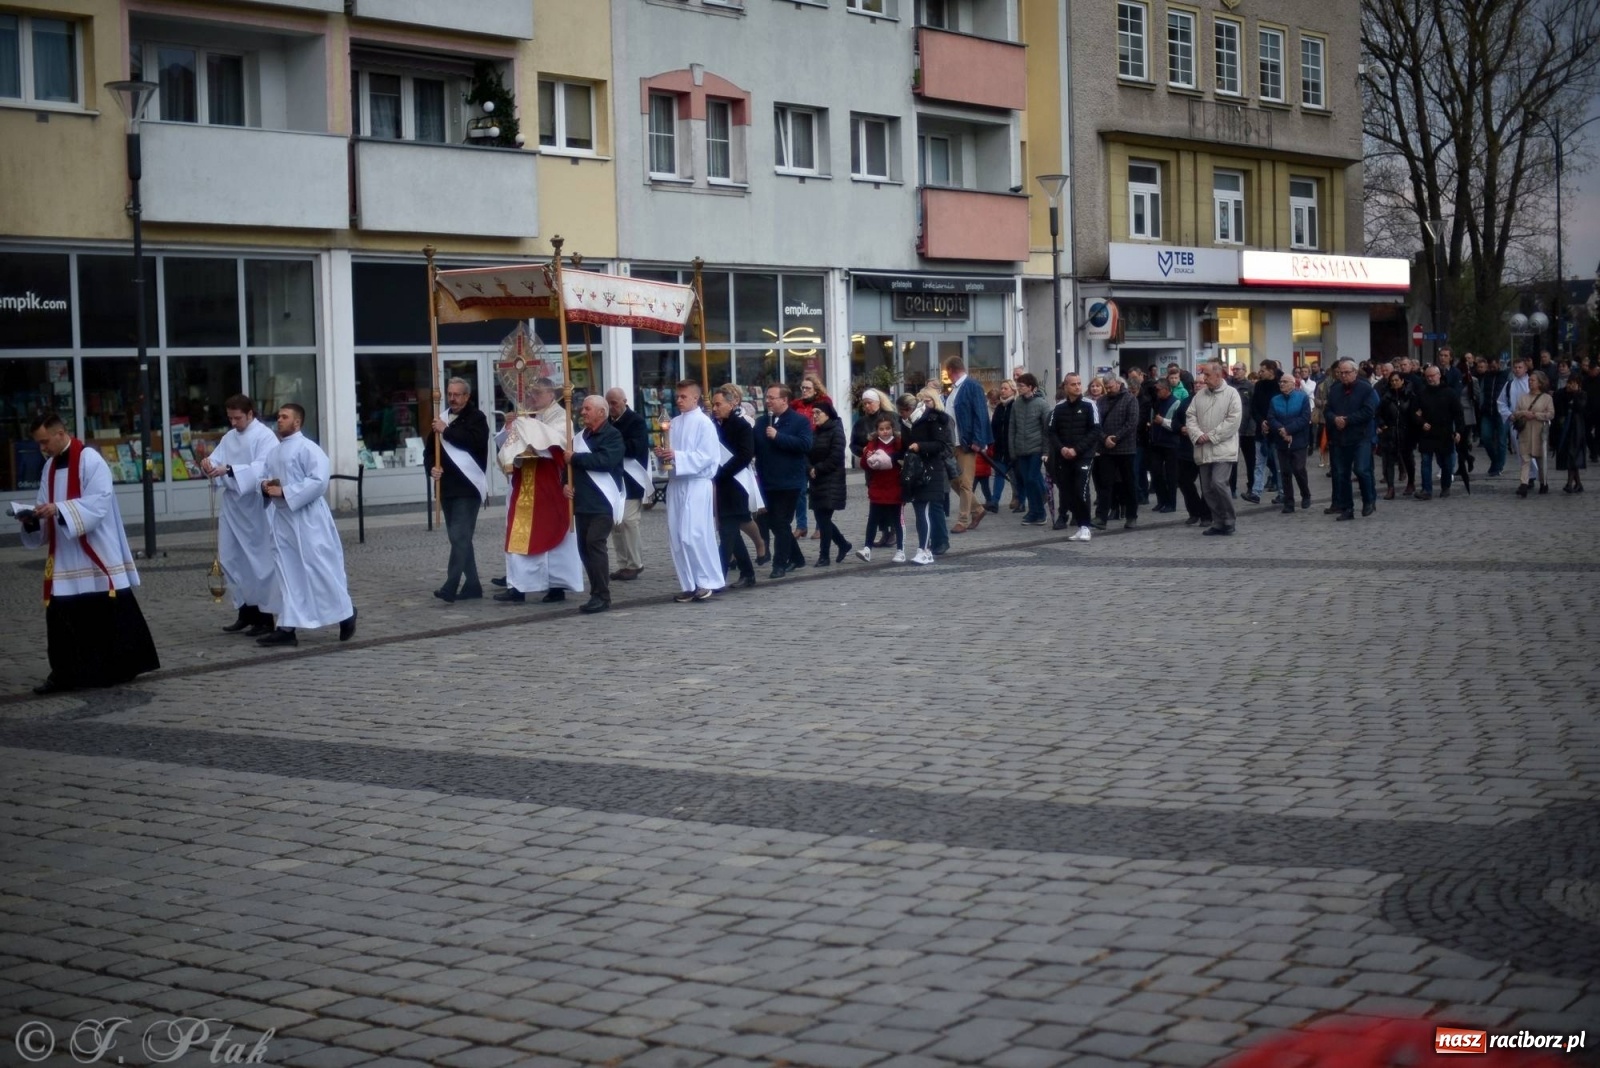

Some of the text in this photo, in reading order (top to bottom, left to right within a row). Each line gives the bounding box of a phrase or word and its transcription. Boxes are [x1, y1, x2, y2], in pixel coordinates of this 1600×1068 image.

[1174, 251, 1195, 265] TEB
[1292, 256, 1369, 279] ROSSMANN
[784, 302, 822, 317] empik.com
